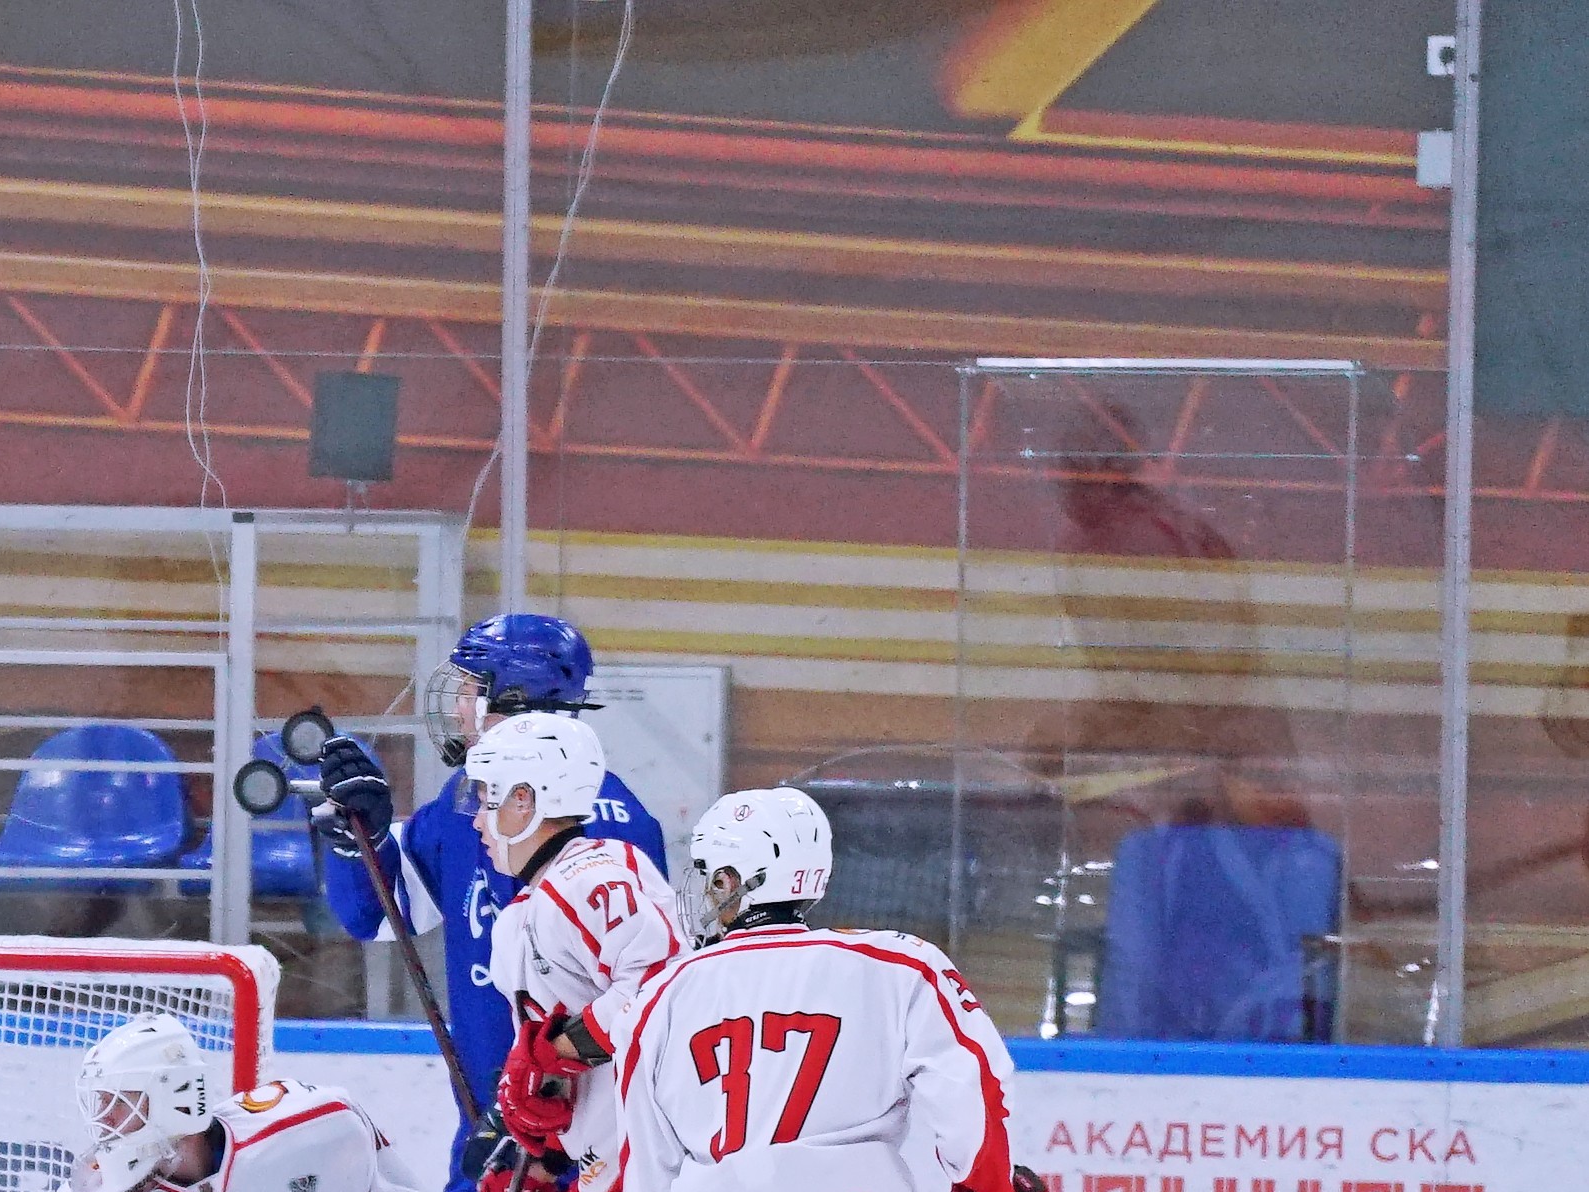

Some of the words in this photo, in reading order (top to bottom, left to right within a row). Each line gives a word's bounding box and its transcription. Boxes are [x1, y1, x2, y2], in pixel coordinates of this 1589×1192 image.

[790, 868, 825, 895] 37
[586, 880, 639, 933] 27
[689, 1010, 842, 1164] 37
[1046, 1120, 1346, 1163] АКАДЕМИЯ
[1370, 1127, 1477, 1165] СКА
